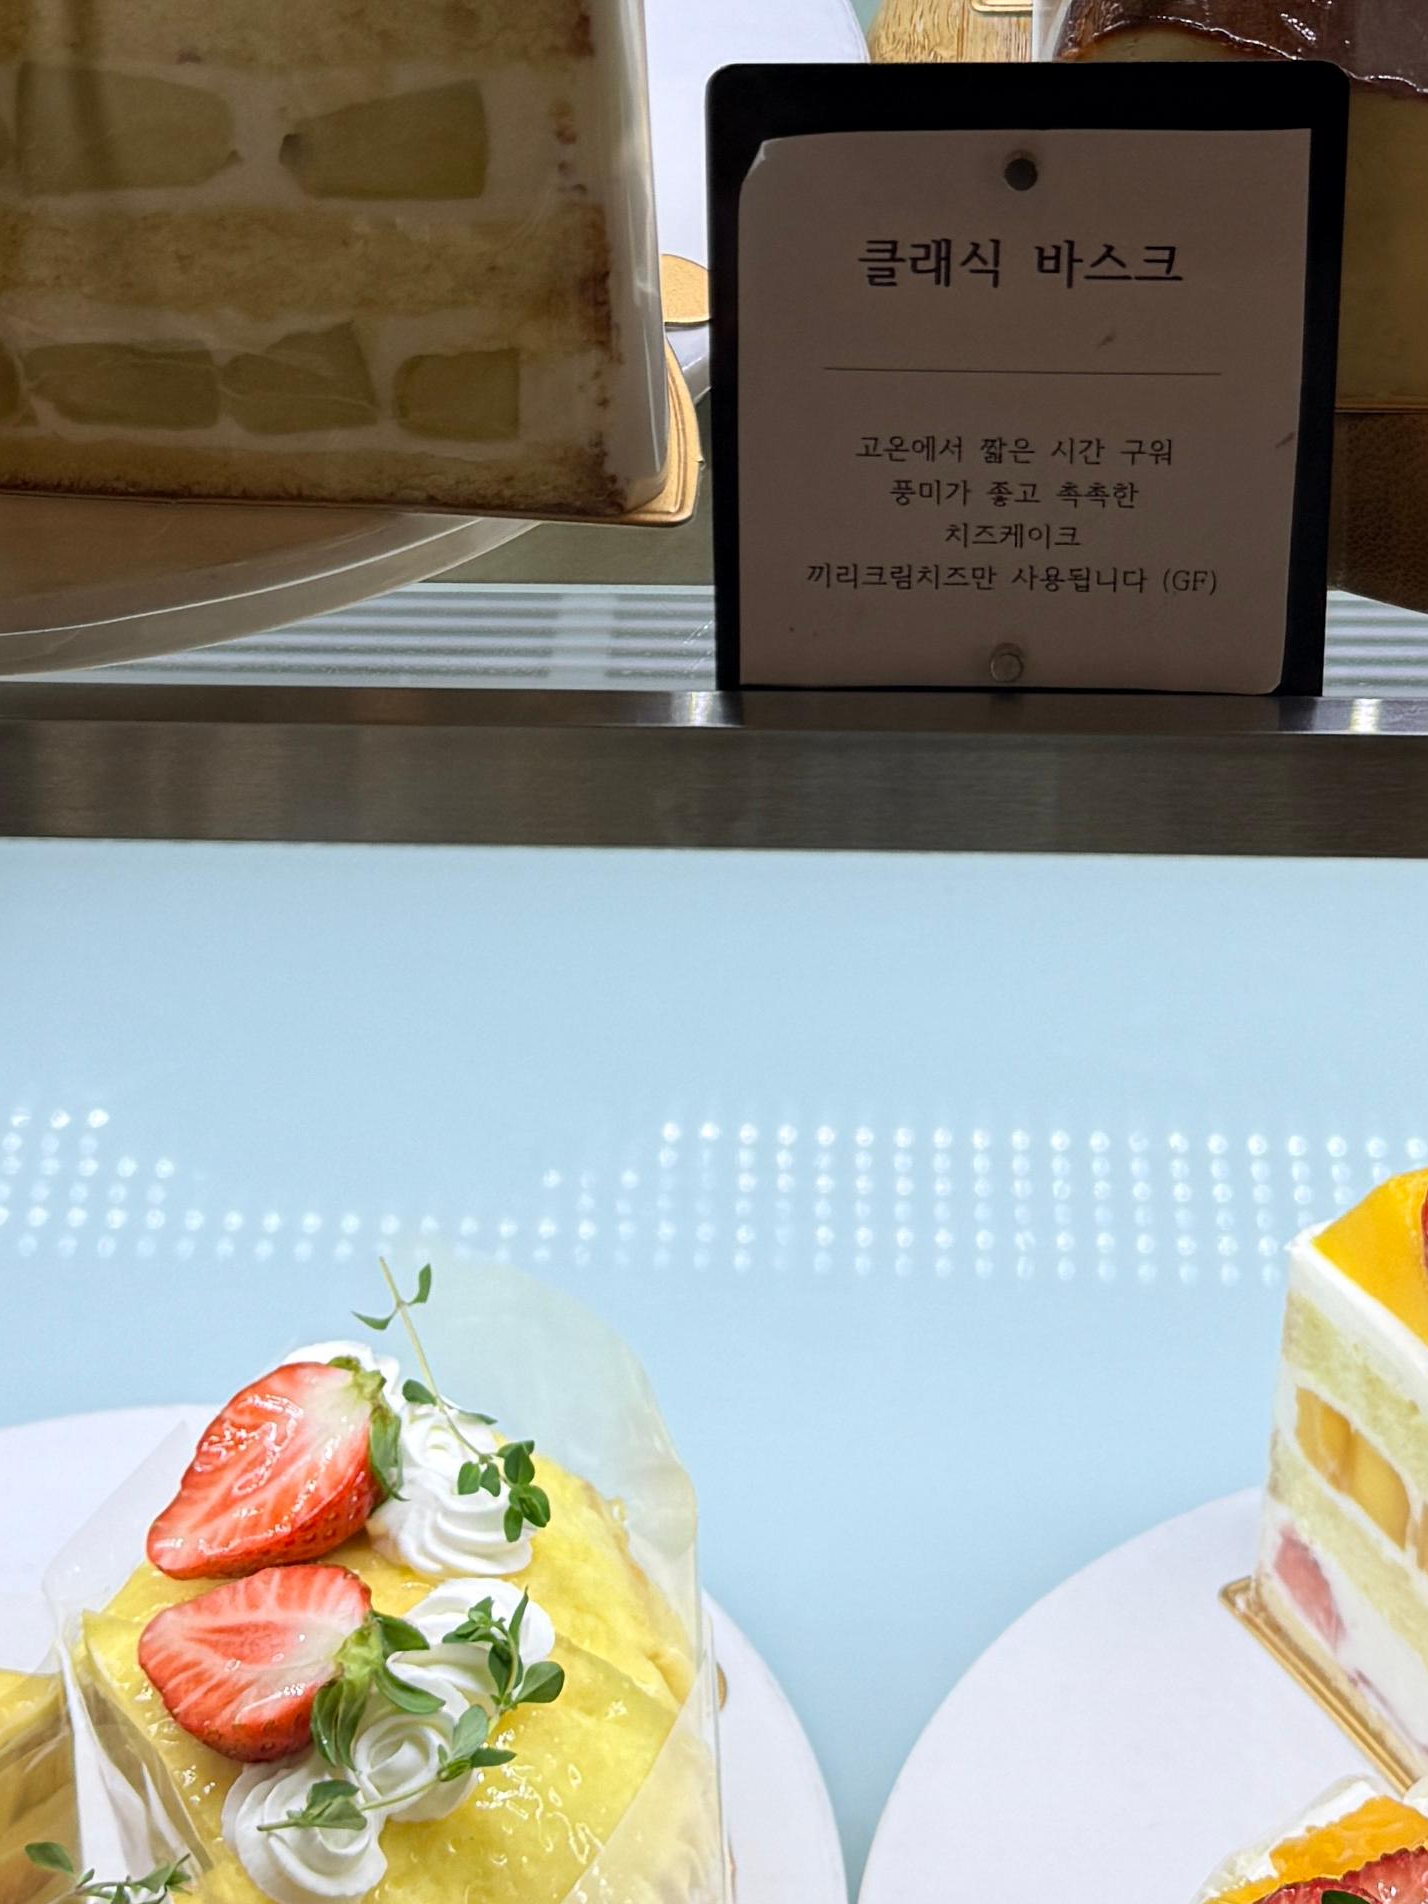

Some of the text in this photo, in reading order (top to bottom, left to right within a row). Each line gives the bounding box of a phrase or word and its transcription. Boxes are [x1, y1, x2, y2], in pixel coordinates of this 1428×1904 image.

[857, 237, 1184, 290] 클래식 바스크
[855, 434, 1173, 467] 고온에서 짧은 시간 구워
[889, 479, 1140, 510] 풍미가 좋고 촉촉한
[944, 521, 1082, 551] 치즈케이크
[806, 562, 1218, 596] 끼리크림치즈만 사용됩니다 (GF)
